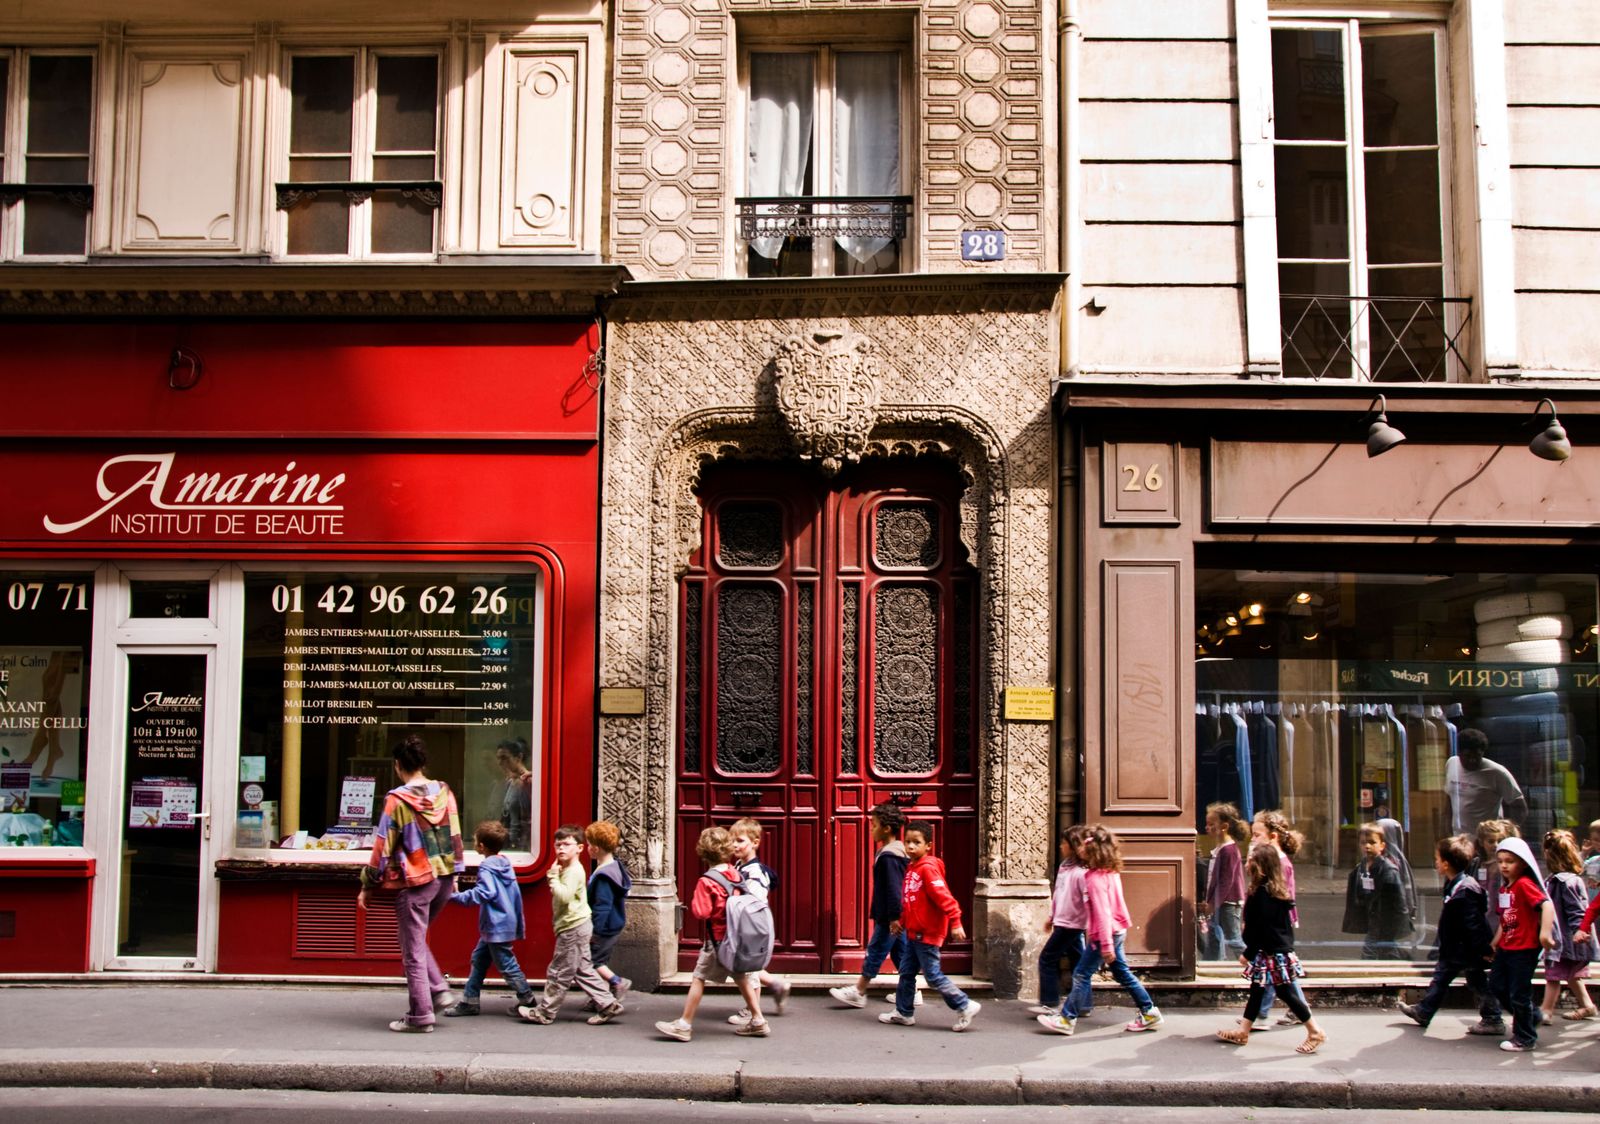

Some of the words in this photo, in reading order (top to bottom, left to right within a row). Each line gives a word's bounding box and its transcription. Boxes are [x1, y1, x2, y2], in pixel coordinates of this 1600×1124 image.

[968, 234, 998, 256] 28
[1122, 464, 1163, 492] 26
[43, 452, 346, 534] Amarine
[111, 514, 206, 534] INSTITUT
[215, 515, 245, 534] DE
[256, 515, 344, 535] BEAUTE
[8, 582, 44, 611] 07
[57, 583, 89, 611] 71
[272, 585, 304, 613] 01
[318, 585, 355, 613] 42
[369, 585, 406, 614] 96
[419, 586, 456, 614] 62
[470, 586, 508, 615] 26
[284, 628, 319, 637] JAMBES
[283, 646, 318, 655] JAMBES
[411, 648, 425, 656] OU
[426, 648, 474, 656] AISSELLES
[21, 655, 48, 668] Calm
[392, 681, 406, 690] OU
[408, 681, 455, 690] AISSELLES
[131, 691, 203, 712] Amarine
[284, 699, 325, 708] MAILLOT
[327, 700, 373, 708] BRESILIEN
[0, 717, 40, 729] ALISE
[43, 717, 88, 729] CELLU
[284, 716, 325, 724] MAILLOT
[327, 716, 378, 725] AMERICAIN
[133, 726, 153, 737] 10H
[155, 726, 162, 737] à
